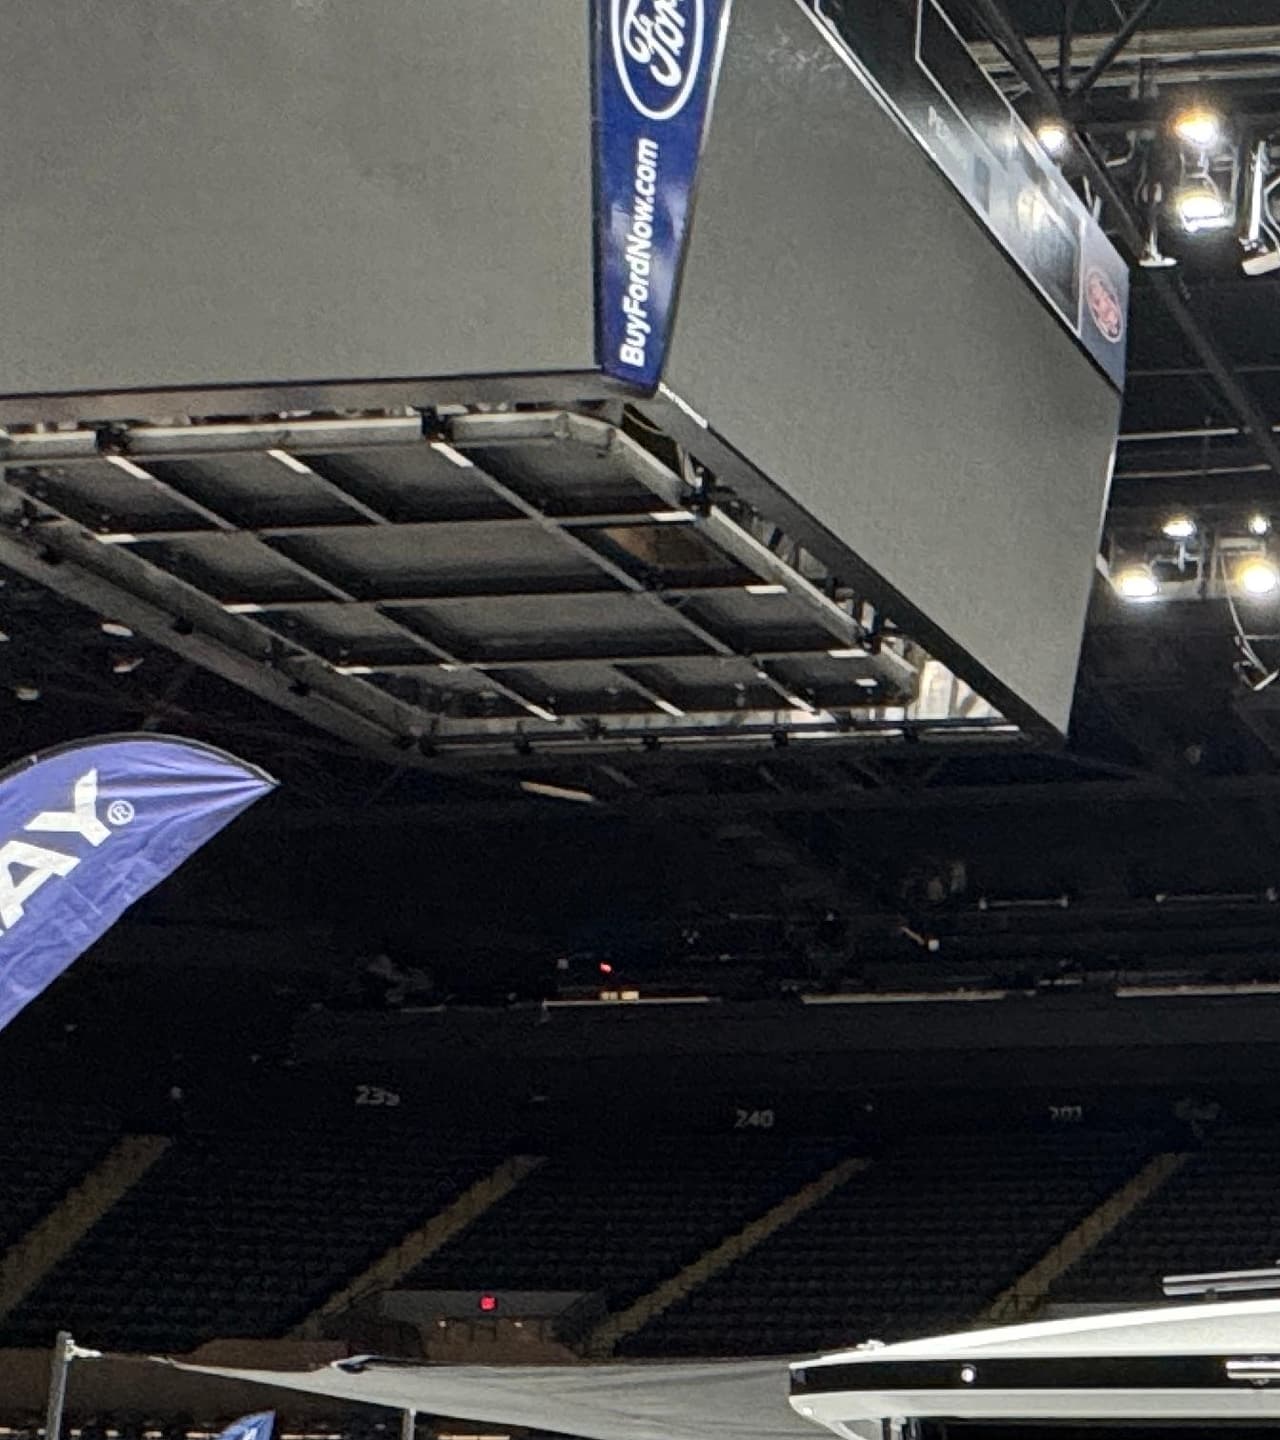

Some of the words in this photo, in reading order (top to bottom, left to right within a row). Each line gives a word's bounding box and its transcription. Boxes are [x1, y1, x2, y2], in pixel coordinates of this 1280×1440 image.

[623, 0, 686, 88] For
[619, 138, 659, 368] BuyFordNow.com
[733, 1107, 775, 1129] 240
